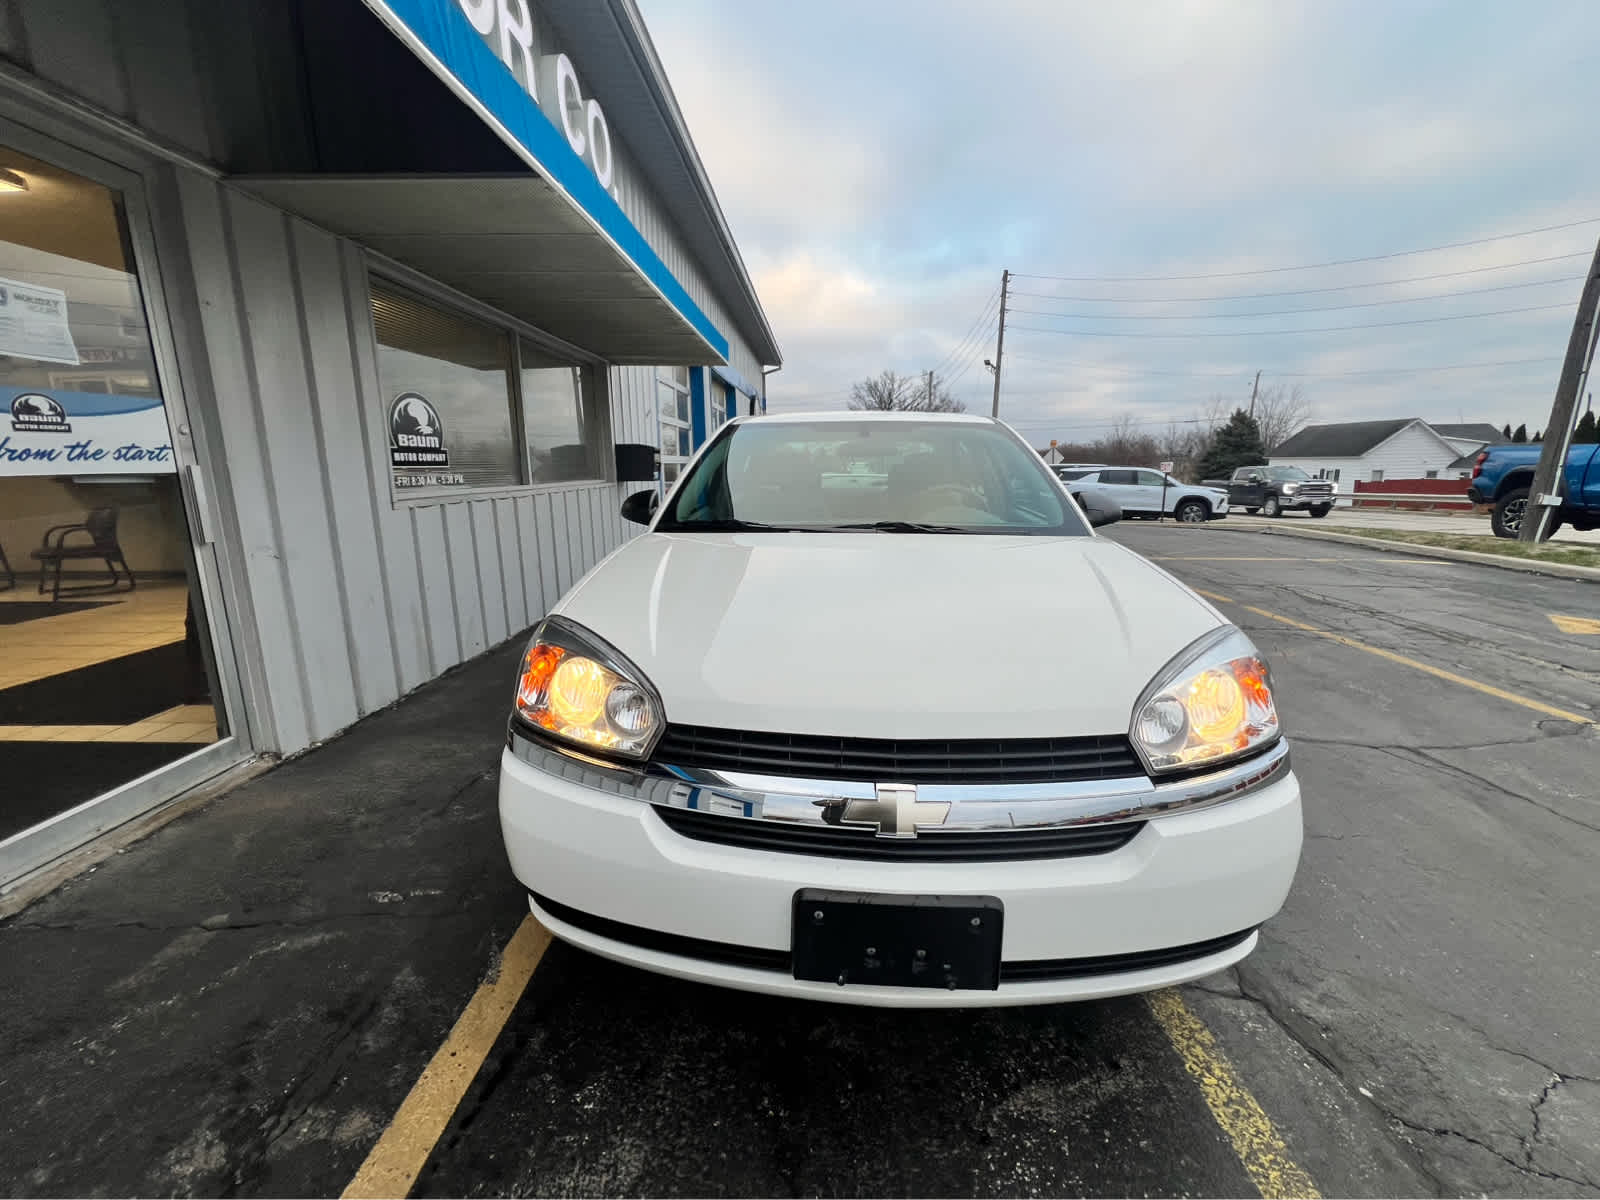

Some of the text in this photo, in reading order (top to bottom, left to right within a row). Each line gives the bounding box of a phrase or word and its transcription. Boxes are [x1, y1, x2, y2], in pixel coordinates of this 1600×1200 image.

[459, 0, 539, 104] R
[398, 434, 440, 448] Baum
[63, 439, 110, 461] the
[112, 443, 173, 462] start.
[393, 452, 418, 462] MOTOR
